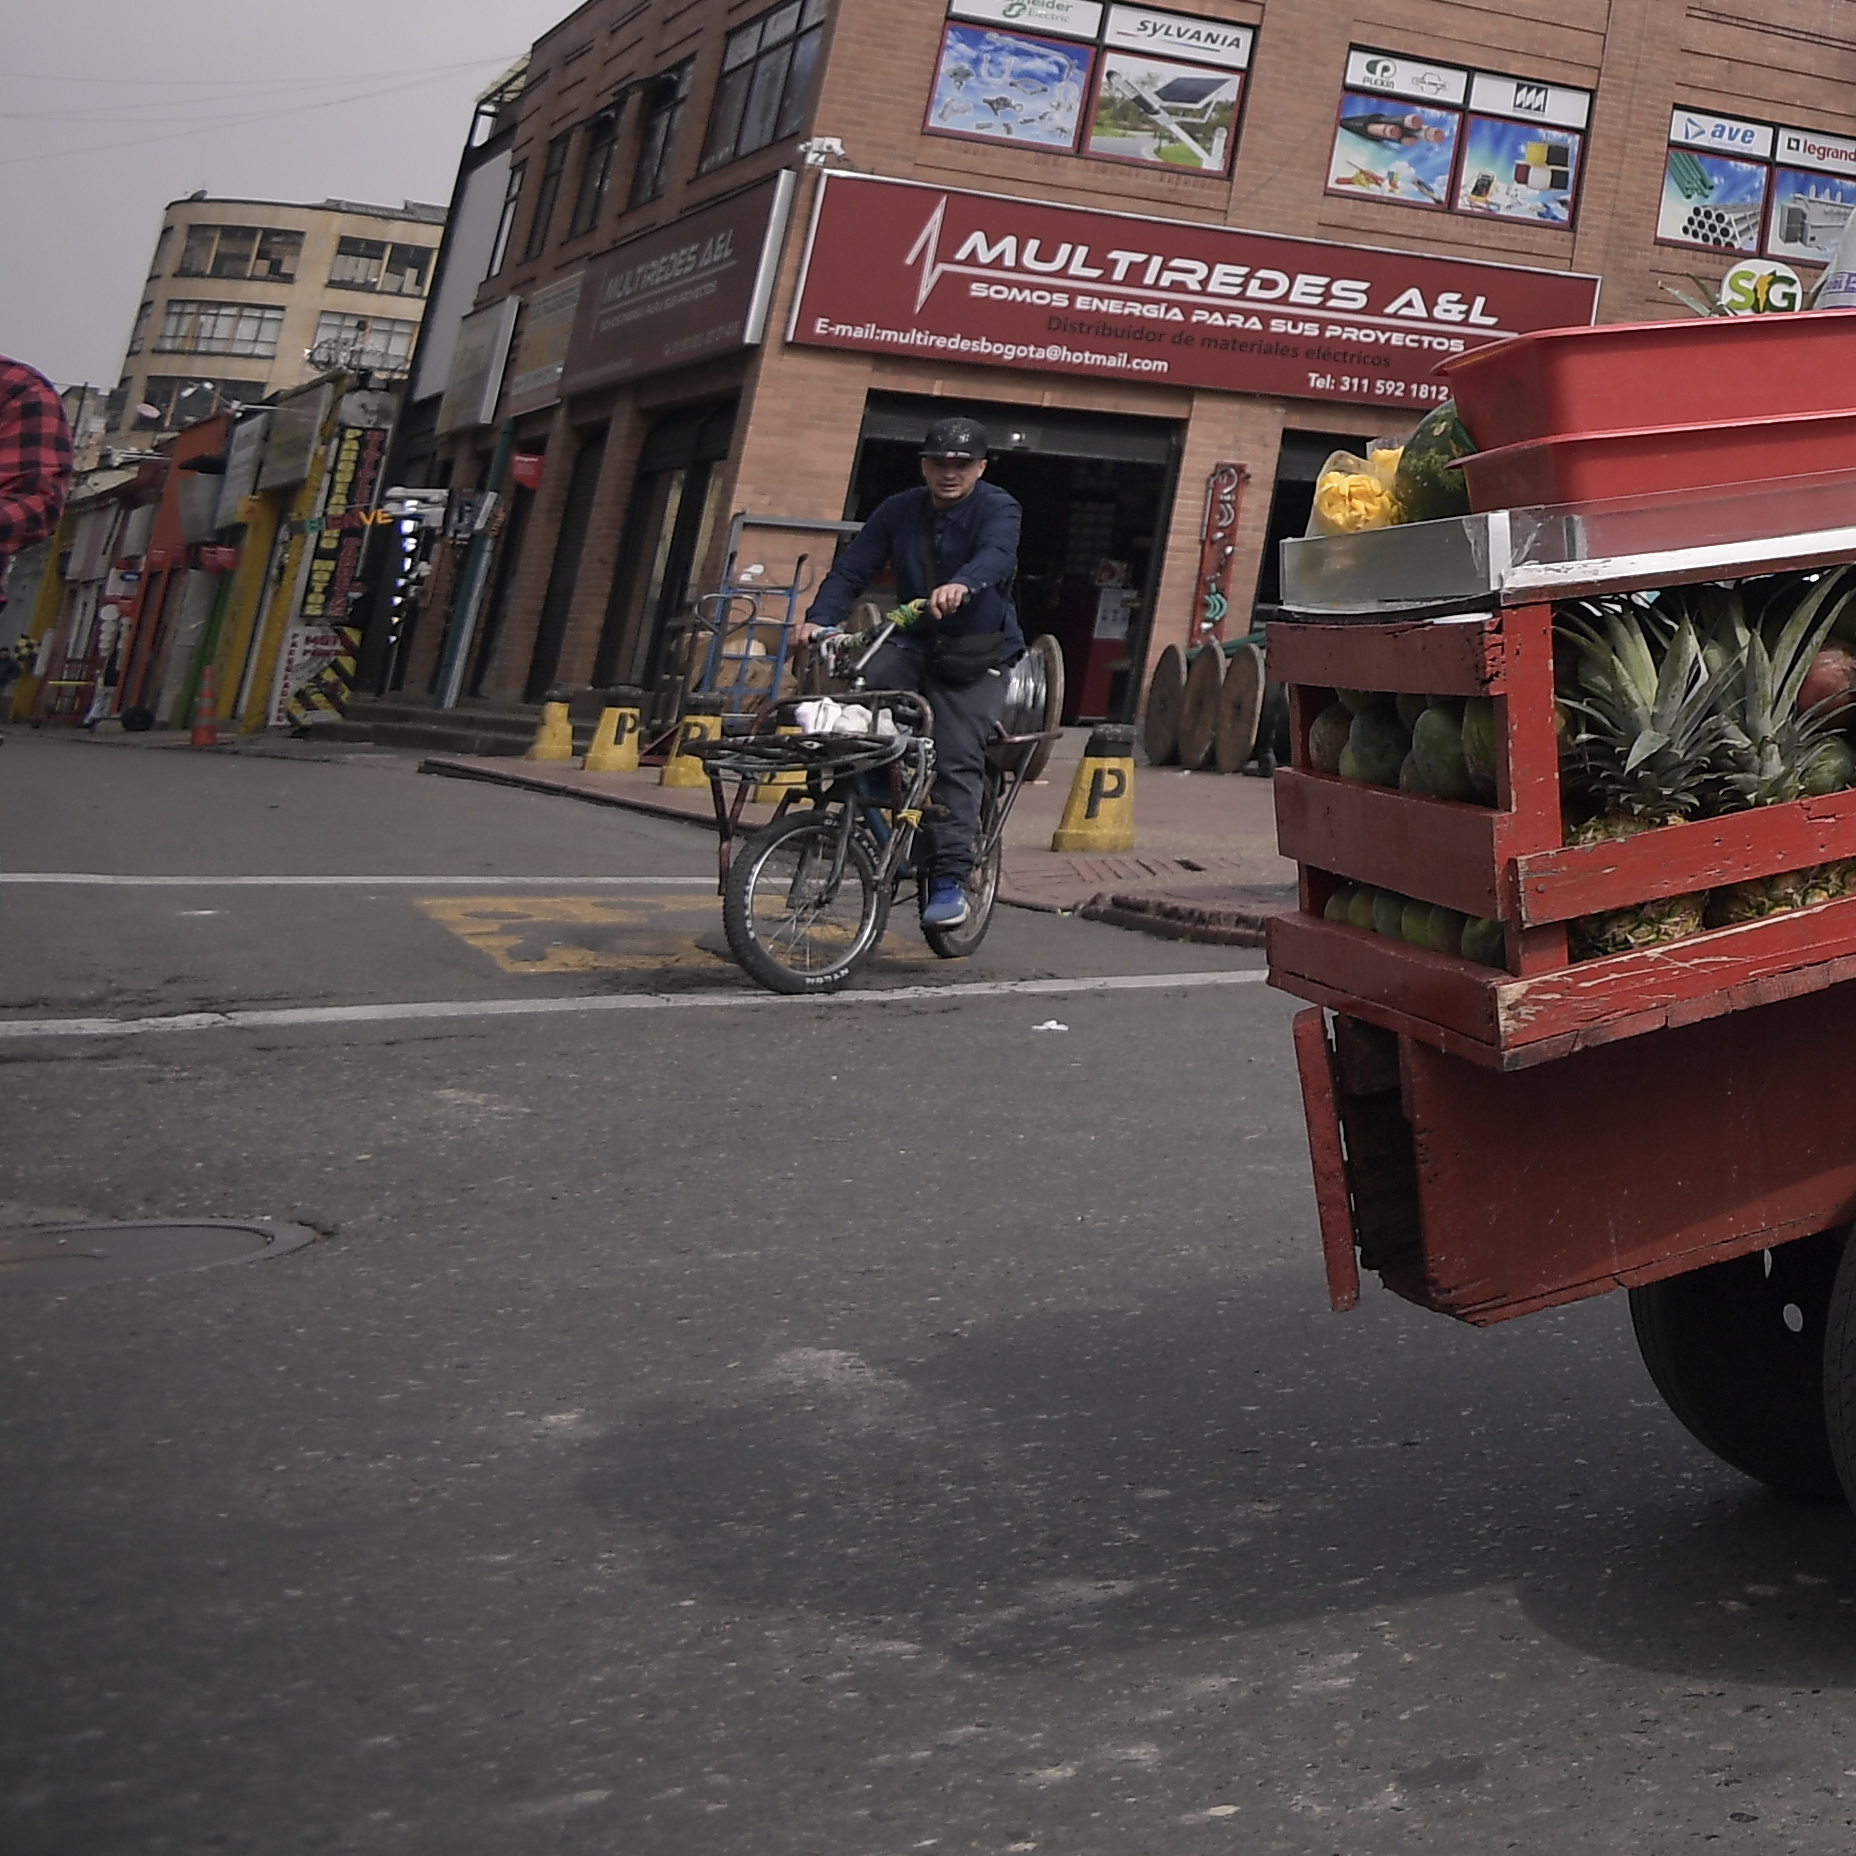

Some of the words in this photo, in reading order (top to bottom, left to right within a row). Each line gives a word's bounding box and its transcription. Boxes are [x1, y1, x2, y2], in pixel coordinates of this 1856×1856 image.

[1028, 8, 1070, 24] Electric
[1136, 19, 1241, 50] SYLVANIA
[1710, 121, 1756, 145] ave
[954, 230, 1372, 311] MULTIREDES
[1383, 287, 1500, 326] A&L
[970, 282, 1070, 308] SOMOS
[1191, 309, 1264, 331] PARA
[1269, 318, 1320, 336] SUS
[1325, 325, 1466, 352] PROYECTOS
[1046, 315, 1167, 342] Distribuidor
[1171, 329, 1195, 346] de
[1201, 335, 1300, 359] materiales
[1307, 372, 1335, 390] Tel:
[1340, 375, 1369, 393] 311
[1375, 379, 1405, 397] 592
[1410, 382, 1449, 401] 1812
[1085, 767, 1127, 820] P
